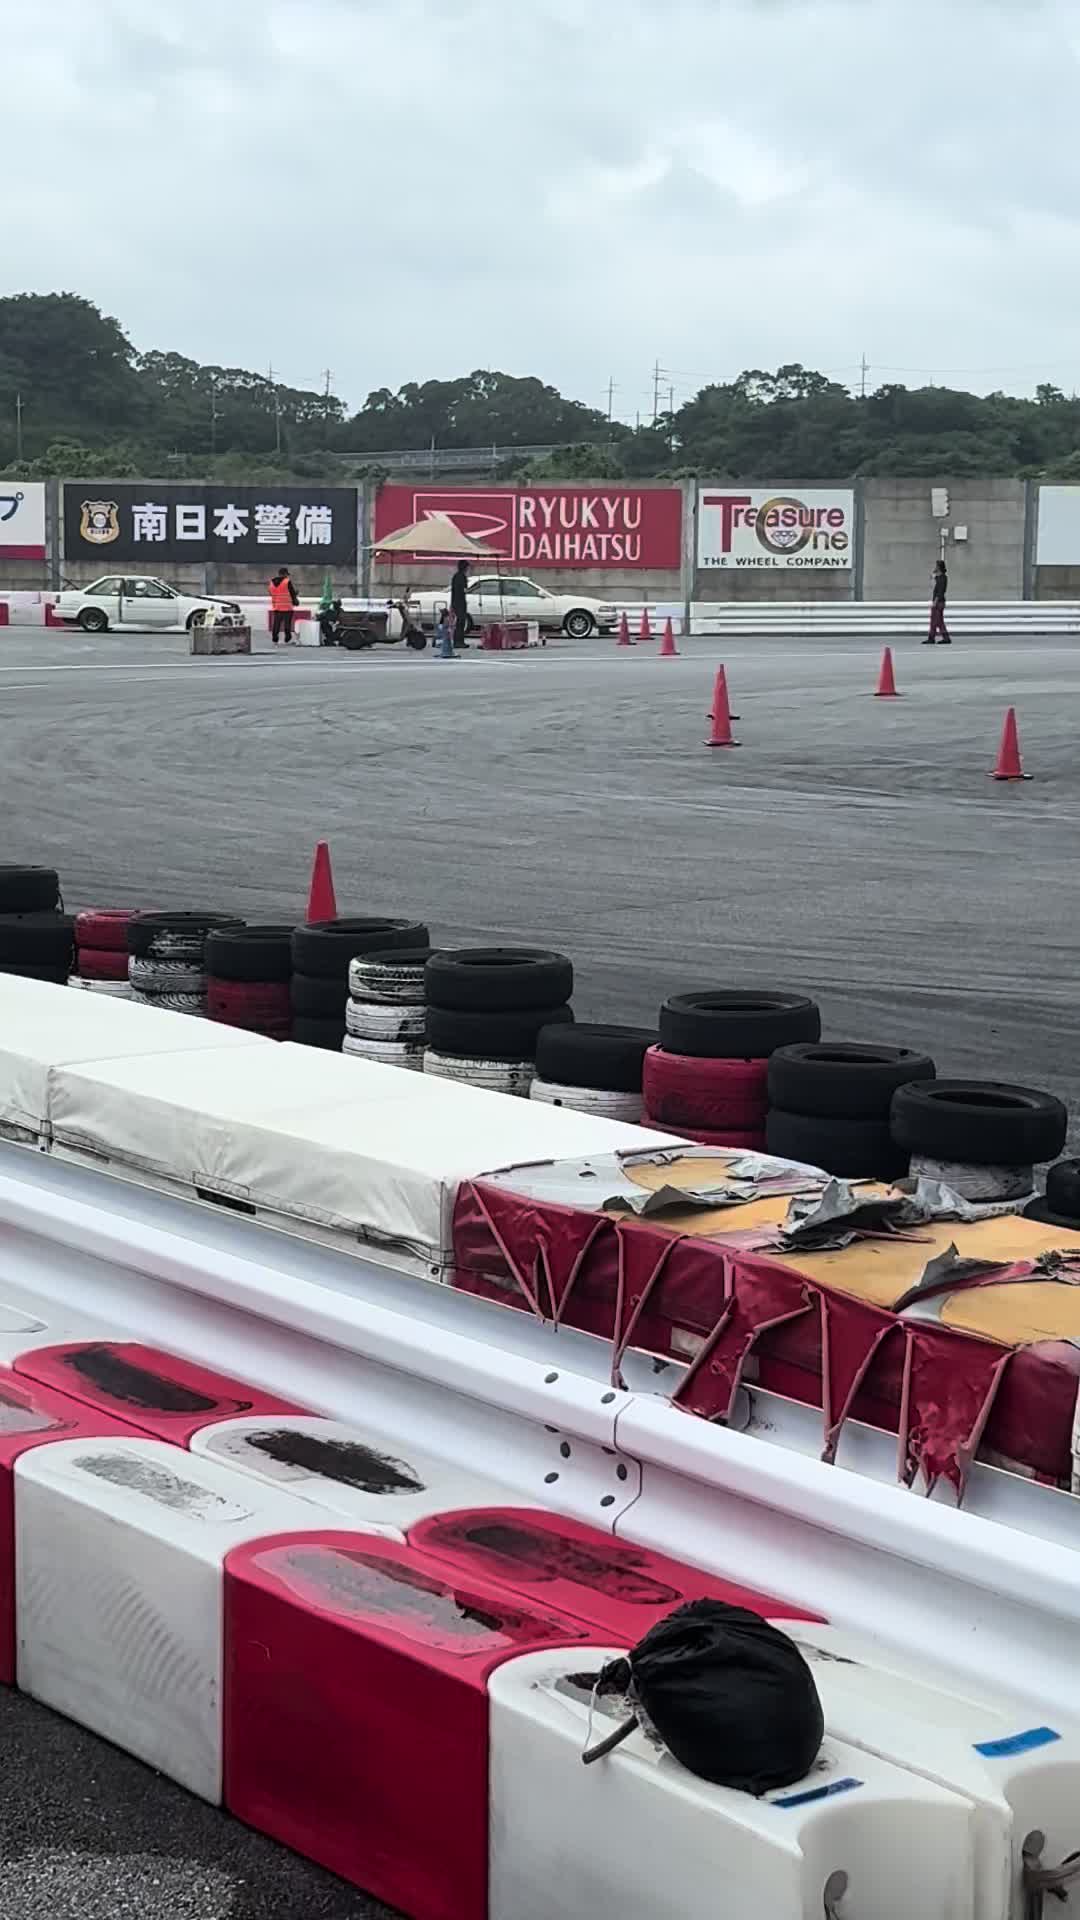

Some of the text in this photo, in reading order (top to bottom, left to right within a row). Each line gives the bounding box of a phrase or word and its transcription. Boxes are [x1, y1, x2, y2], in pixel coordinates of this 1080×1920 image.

[131, 502, 333, 545] 南日本警備
[519, 496, 641, 528] RYUKYU
[703, 496, 845, 552] Treasure
[519, 532, 641, 560] DAIHATSU
[704, 557, 848, 566] THE WHEEL COMPANY
